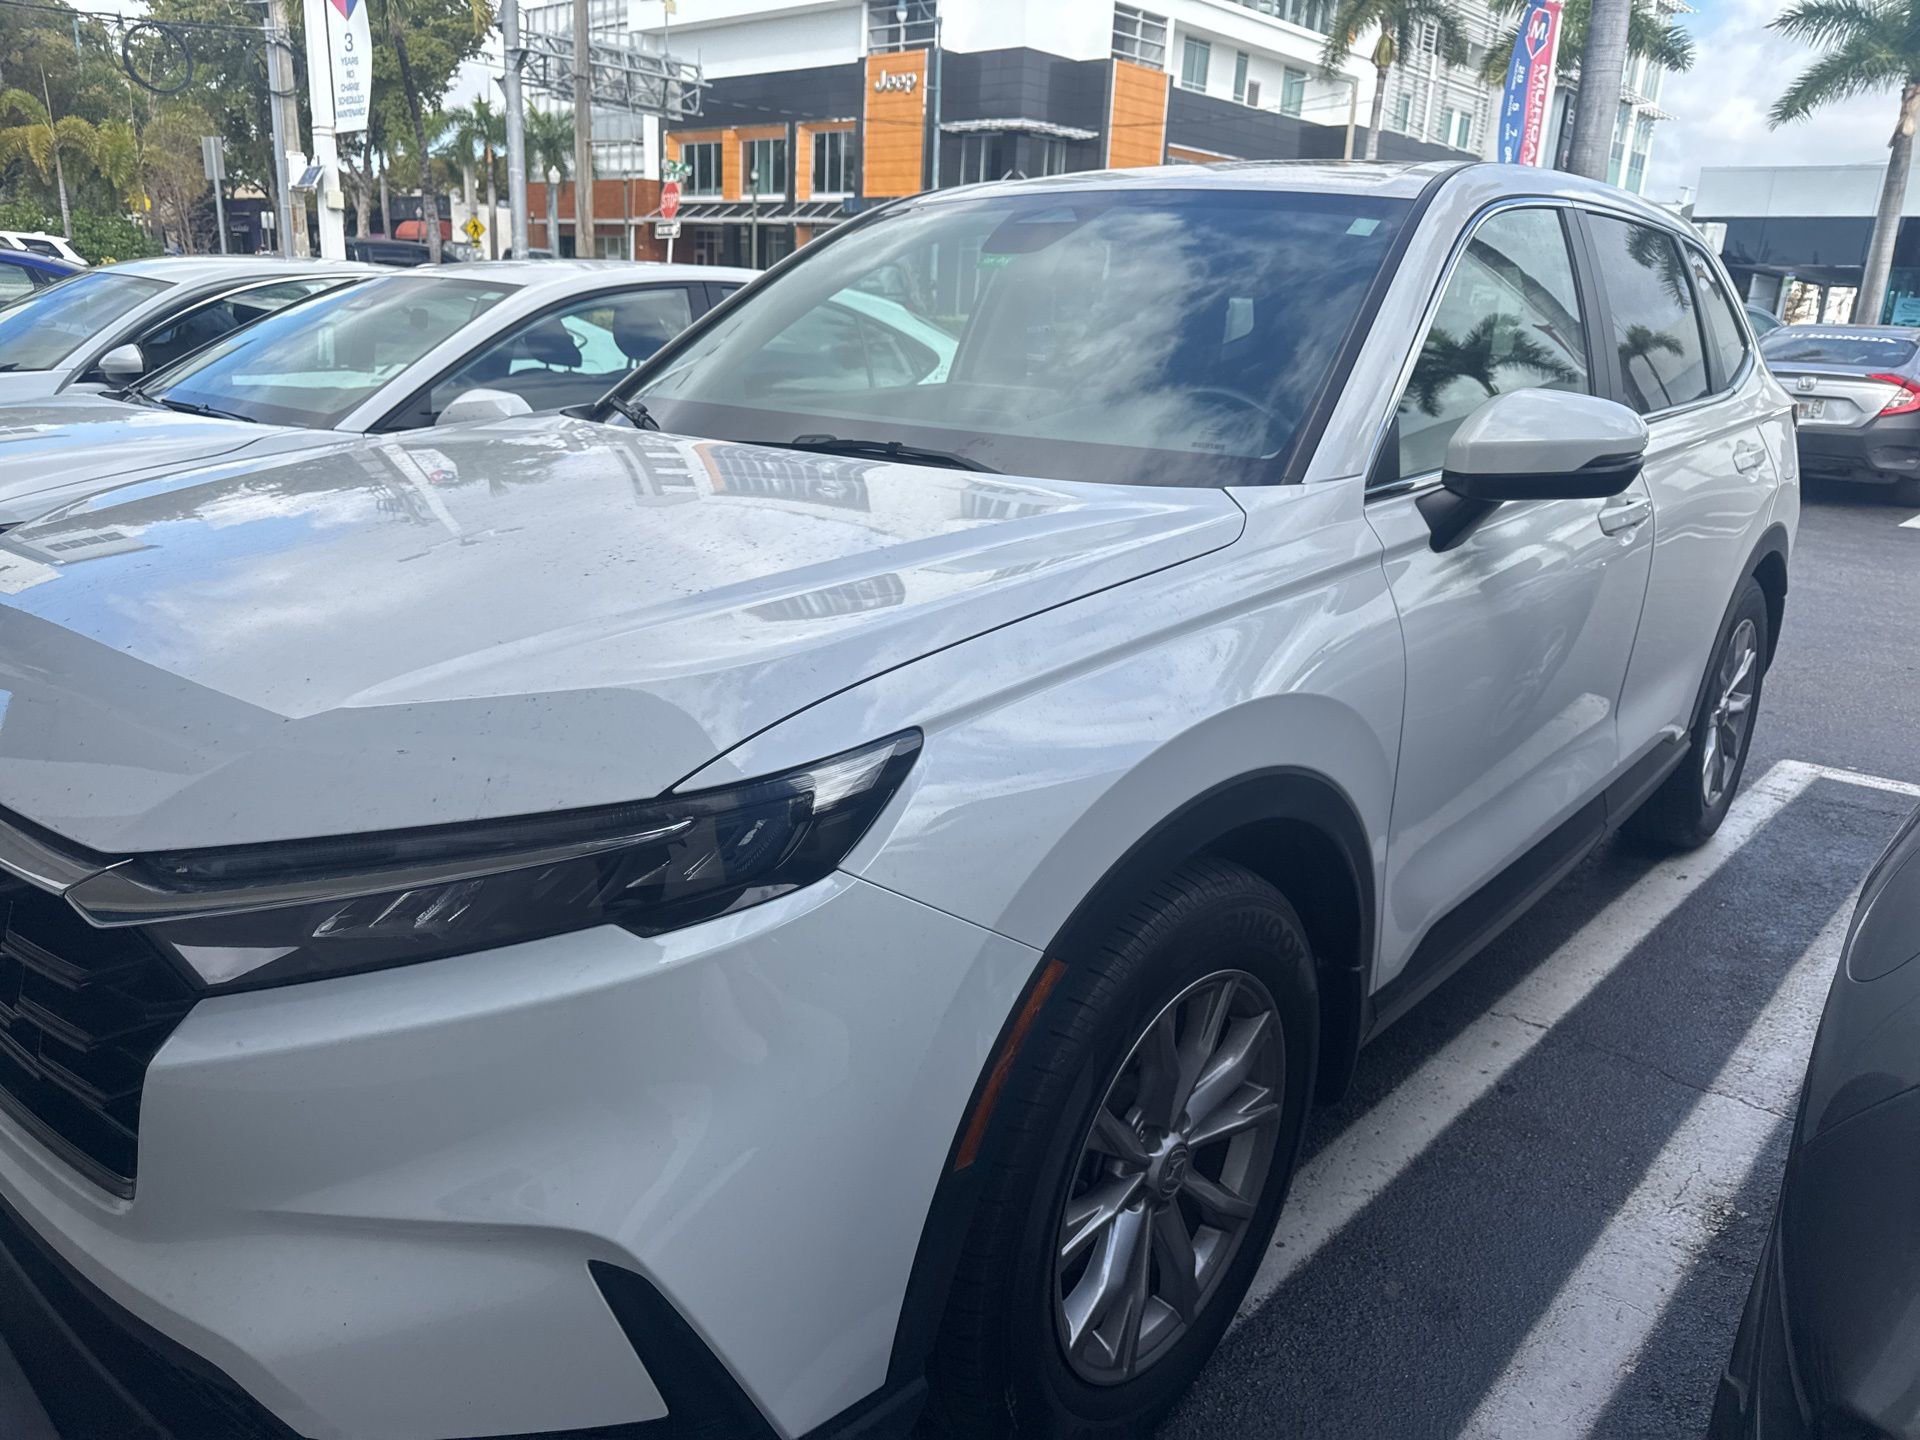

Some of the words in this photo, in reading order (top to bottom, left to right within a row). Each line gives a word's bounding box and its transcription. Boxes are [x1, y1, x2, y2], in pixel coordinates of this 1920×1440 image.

[1530, 20, 1546, 40] M
[344, 32, 354, 52] 3
[340, 56, 359, 66] YEARS
[346, 69, 355, 79] NO
[340, 82, 360, 93] CHARGE
[874, 70, 917, 93] Jeep
[661, 192, 678, 209] STOP
[1807, 333, 1896, 344] HONDA
